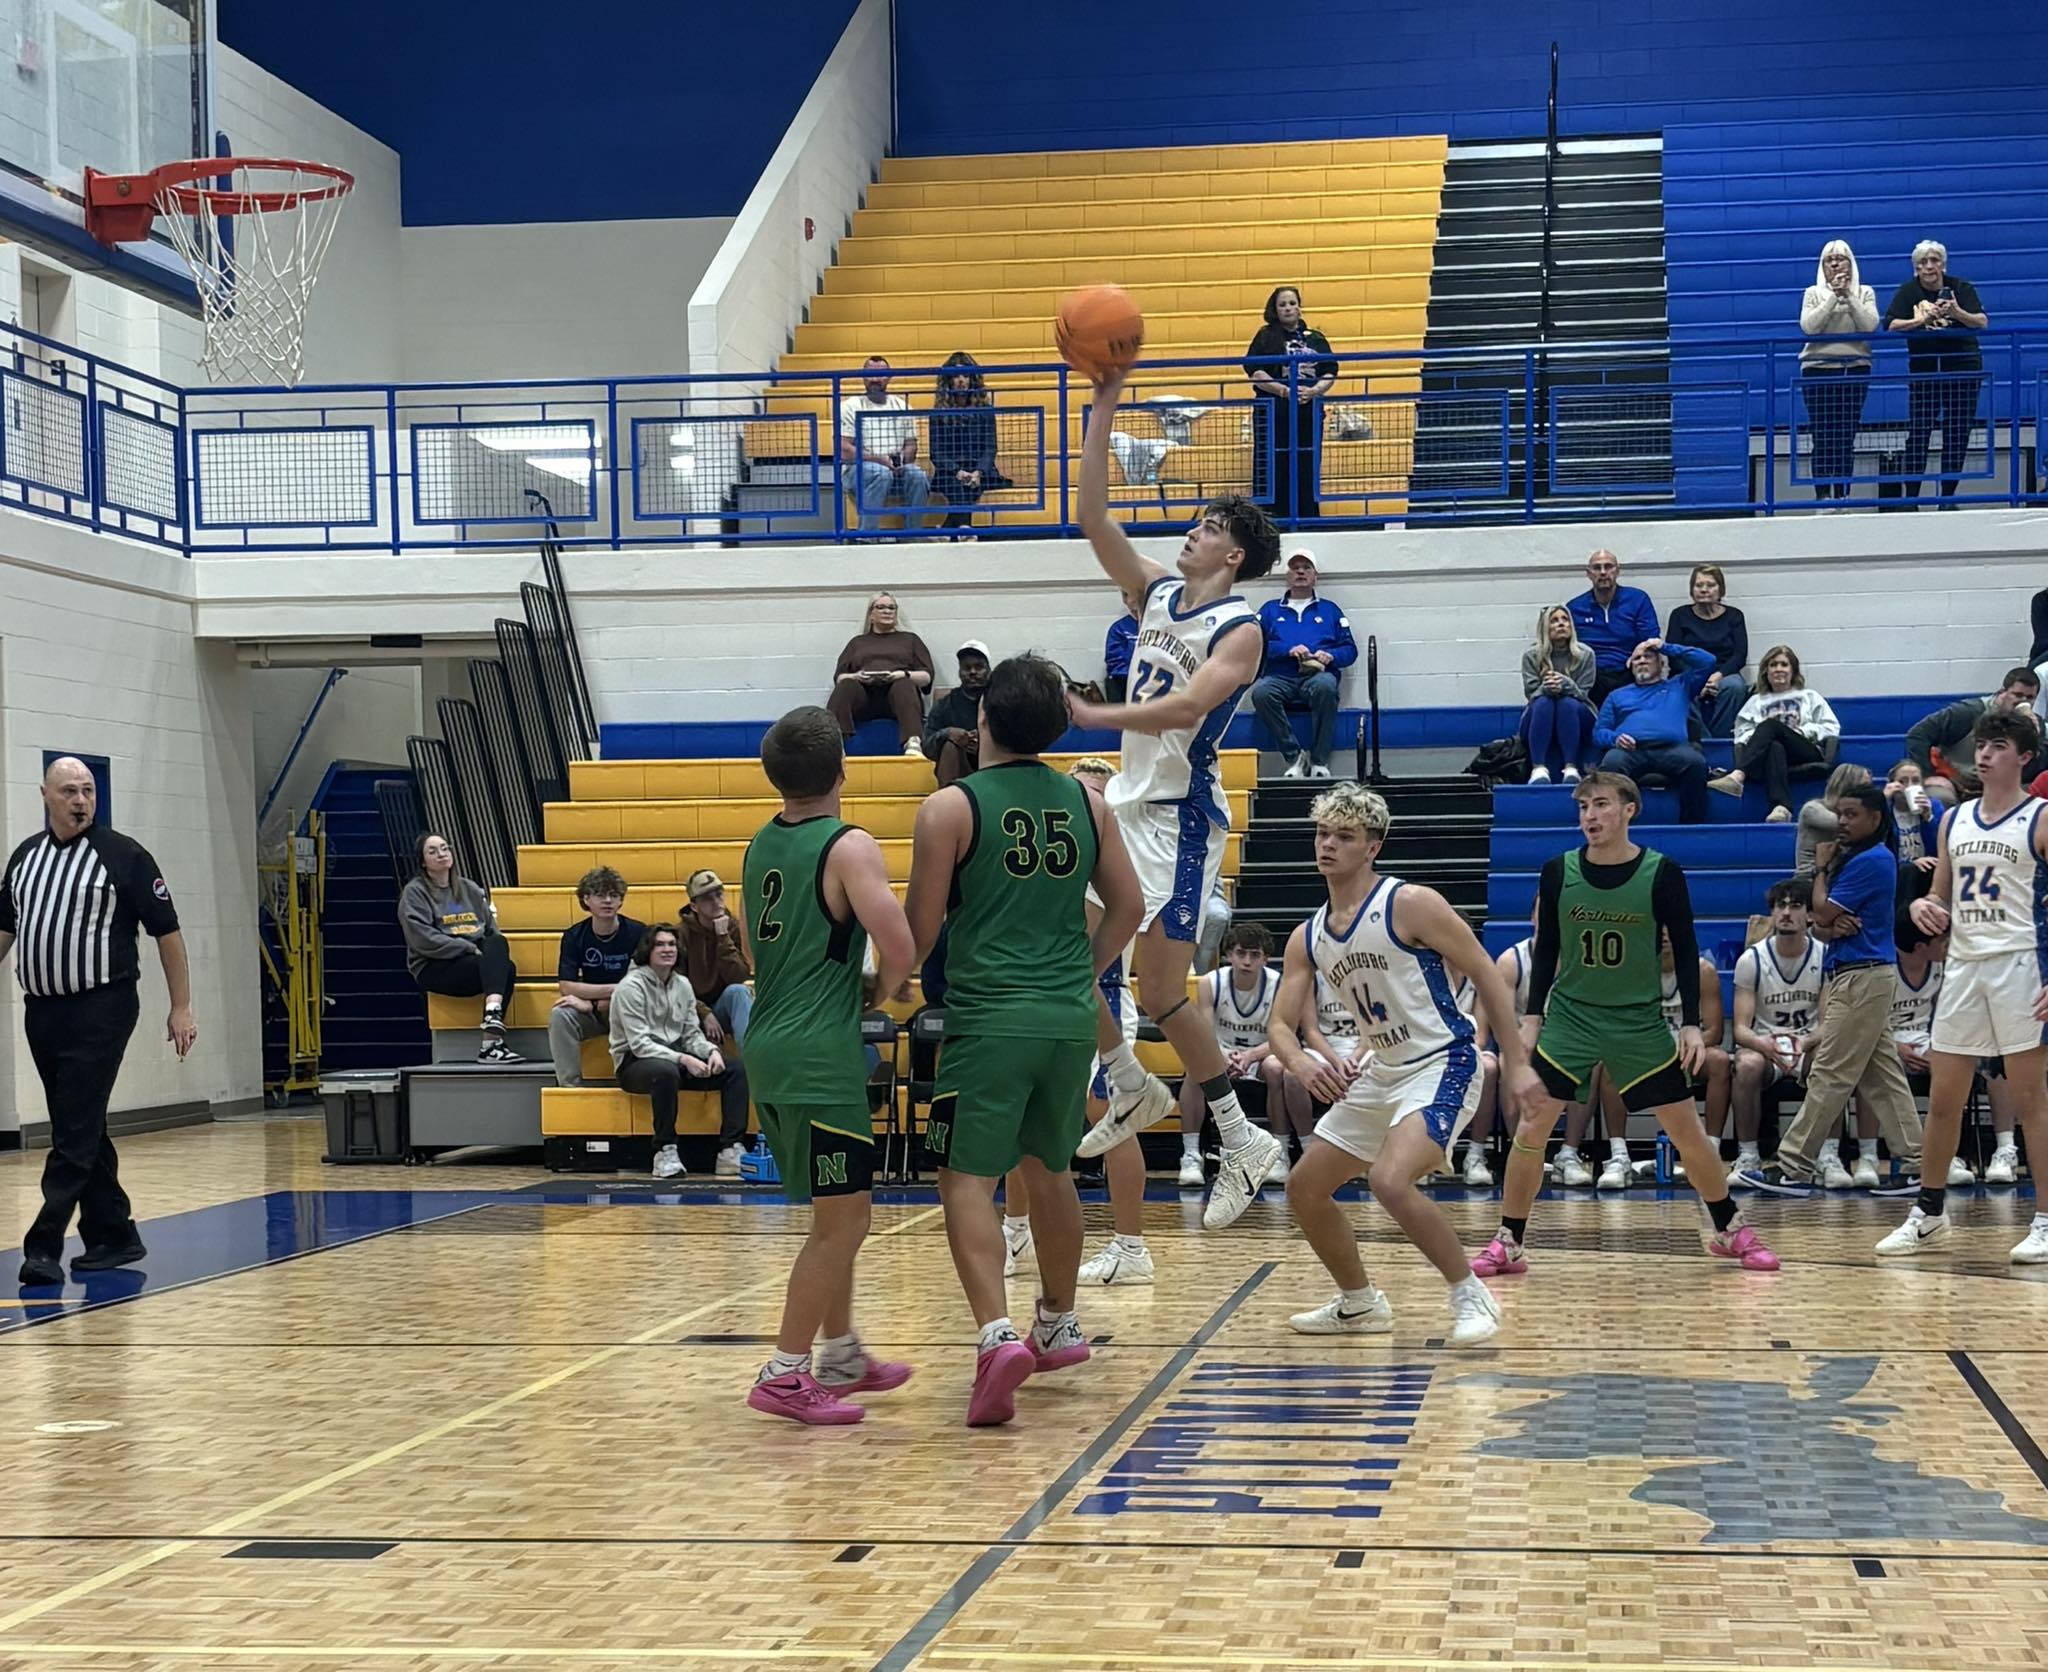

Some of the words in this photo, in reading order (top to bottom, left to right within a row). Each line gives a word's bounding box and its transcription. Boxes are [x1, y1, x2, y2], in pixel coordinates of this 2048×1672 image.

[1131, 658, 1174, 702] 22
[1001, 807, 1079, 878] 35
[1953, 840, 2018, 864] ATLINBURG
[1959, 866, 2000, 902] 24
[757, 869, 784, 942] 2
[1581, 928, 1624, 968] 10
[1352, 982, 1388, 1026] 14
[925, 1119, 949, 1154] N
[816, 1152, 848, 1186] N
[1071, 1362, 1437, 1518] PITTMAN
